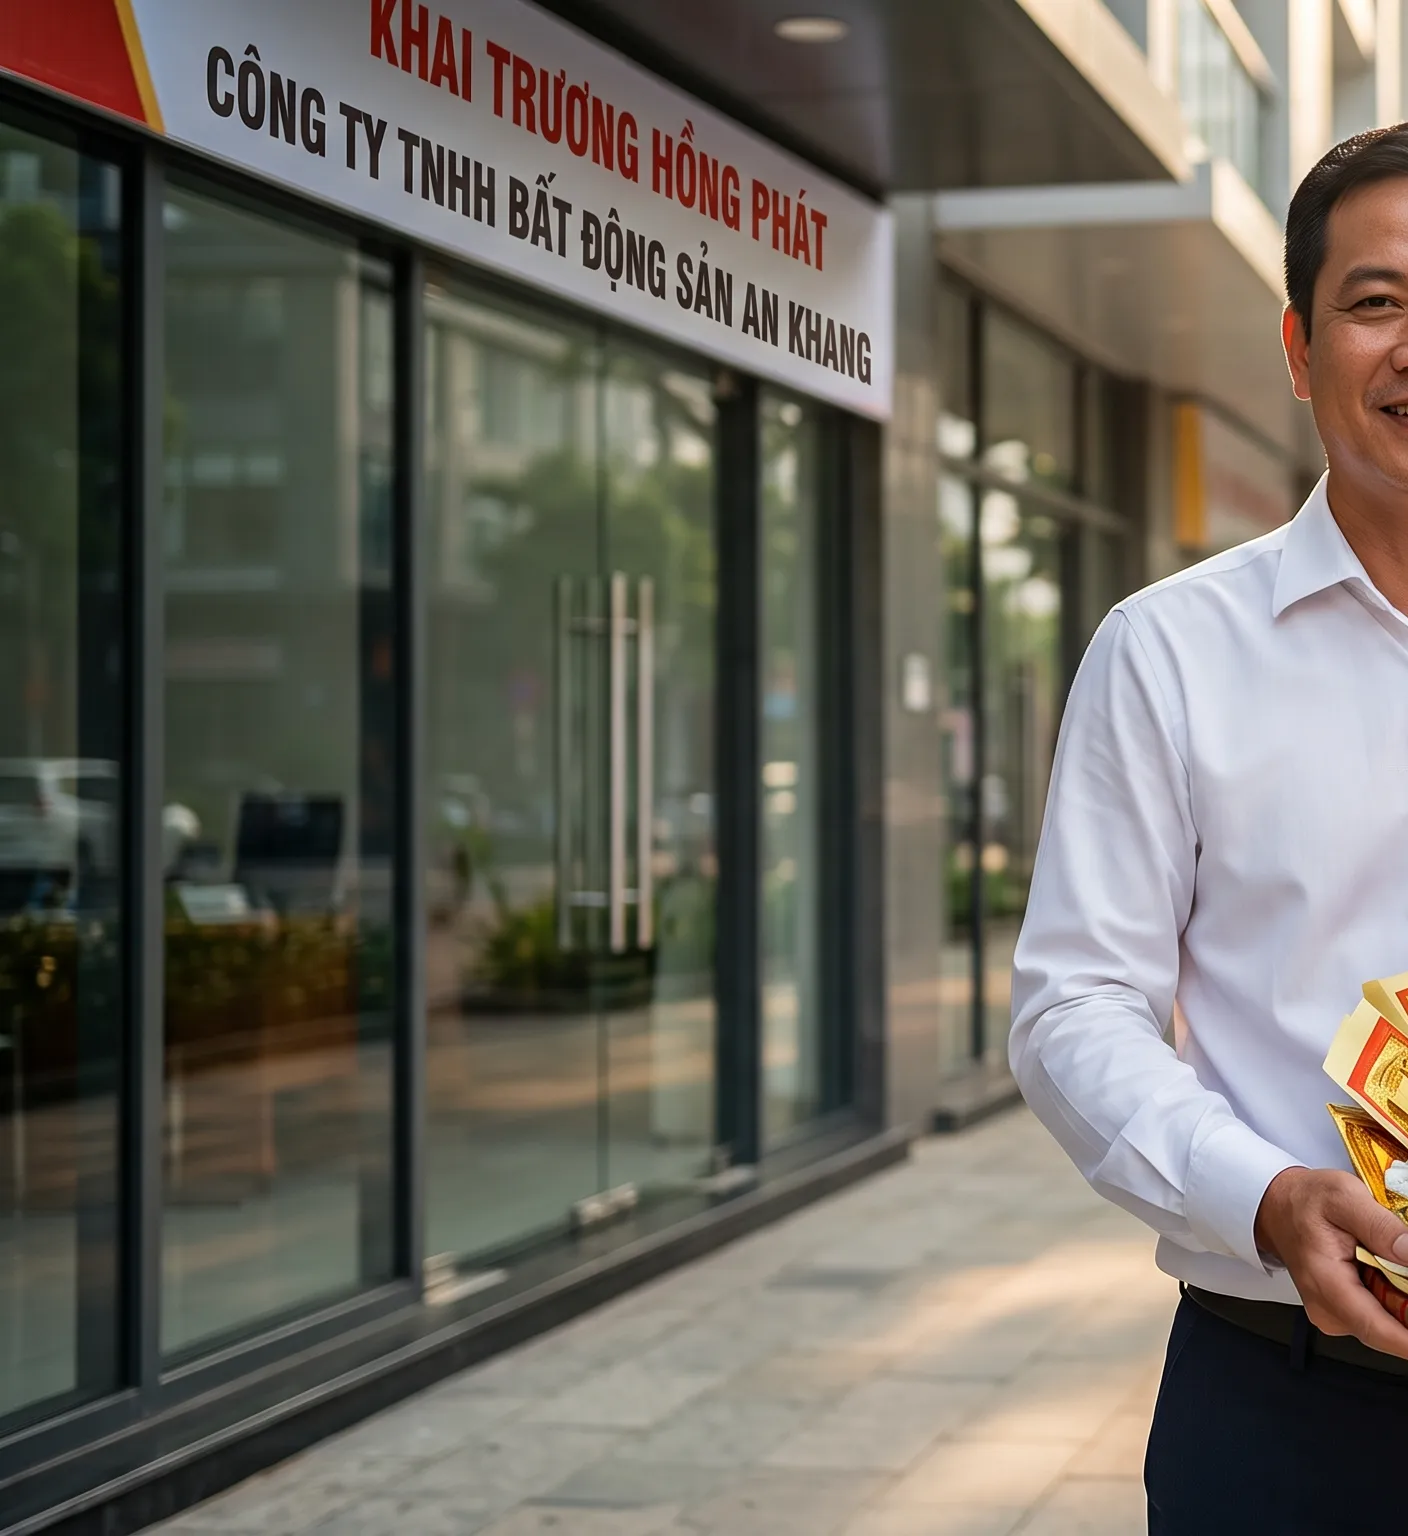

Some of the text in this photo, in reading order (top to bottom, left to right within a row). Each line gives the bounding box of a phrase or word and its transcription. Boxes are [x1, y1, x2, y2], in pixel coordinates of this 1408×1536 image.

[206, 43, 871, 386] CÔNG TY TNHH BẤT ĐỘNG SẢN AN KHANG
[370, 0, 828, 271] KHAI TRƯƠNG HỒNG PHÁT
